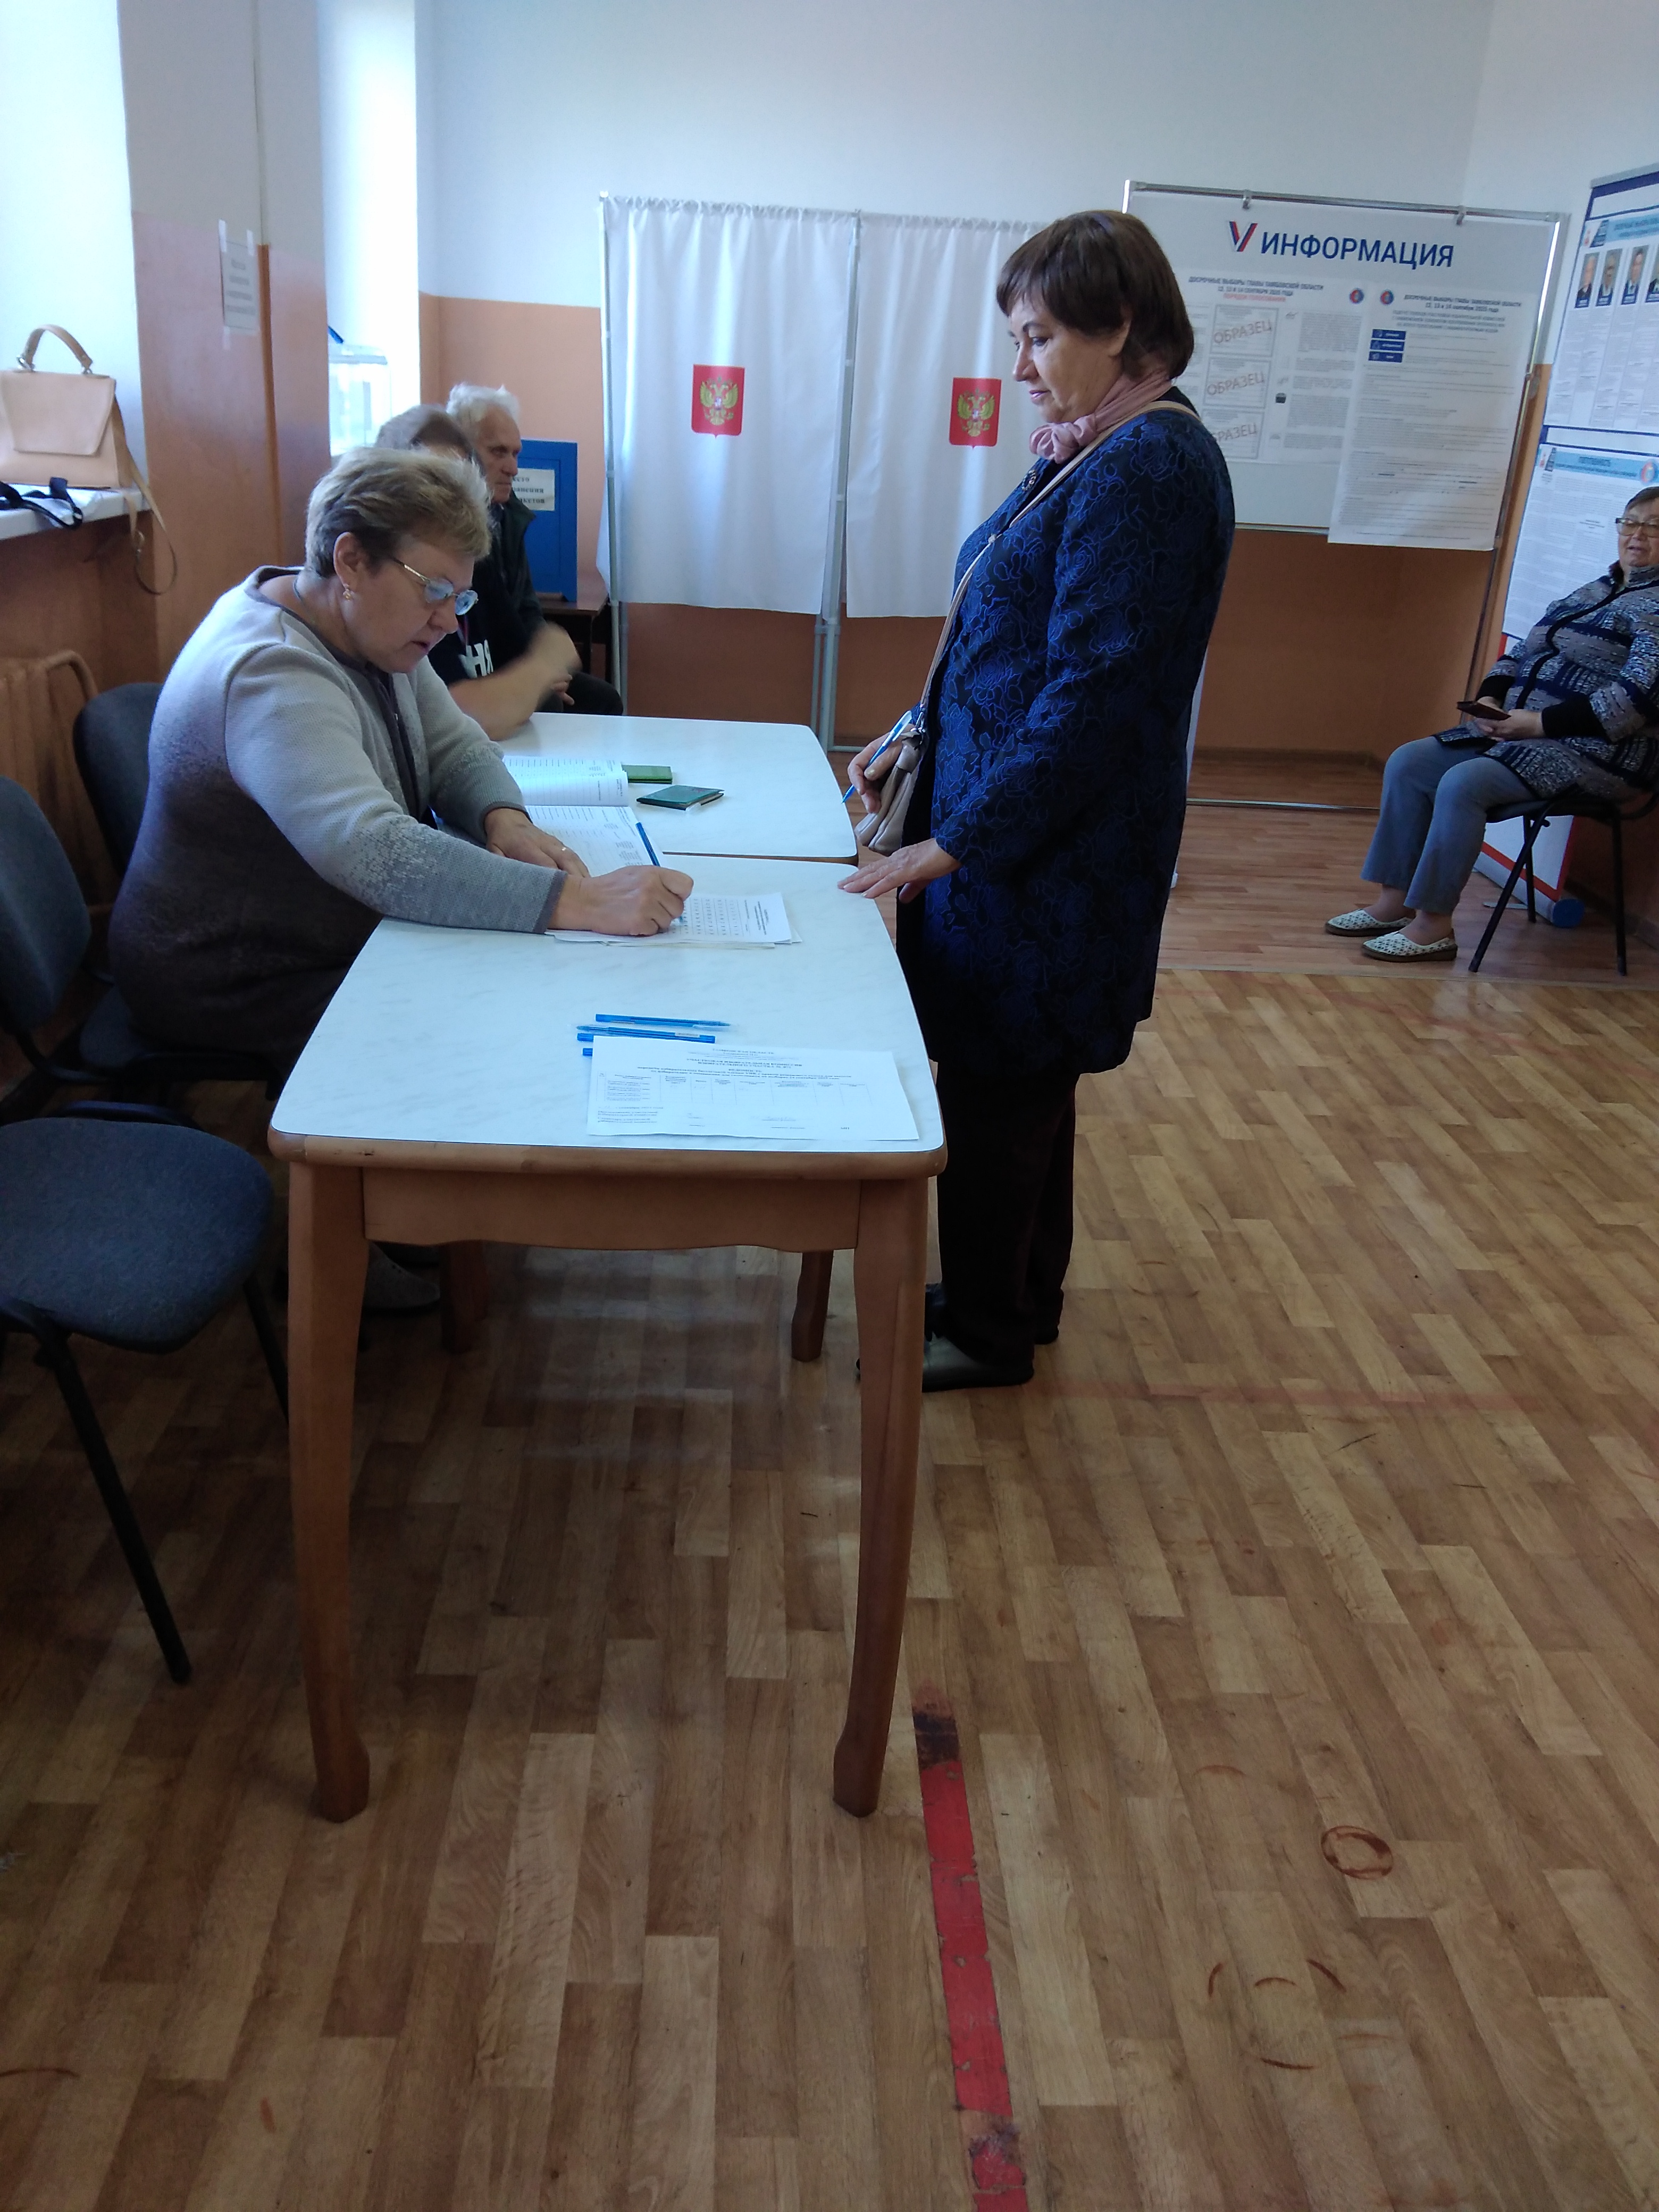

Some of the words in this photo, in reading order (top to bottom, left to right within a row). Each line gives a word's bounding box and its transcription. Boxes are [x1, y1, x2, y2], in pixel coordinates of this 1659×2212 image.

[1261, 231, 1454, 270] ИНФОРМАЦИЯ
[1213, 319, 1271, 343] ОБРАЗЕЦ
[1207, 372, 1264, 396] ОБРАЗЕЦ
[1213, 422, 1257, 442] РАЗЕЦ
